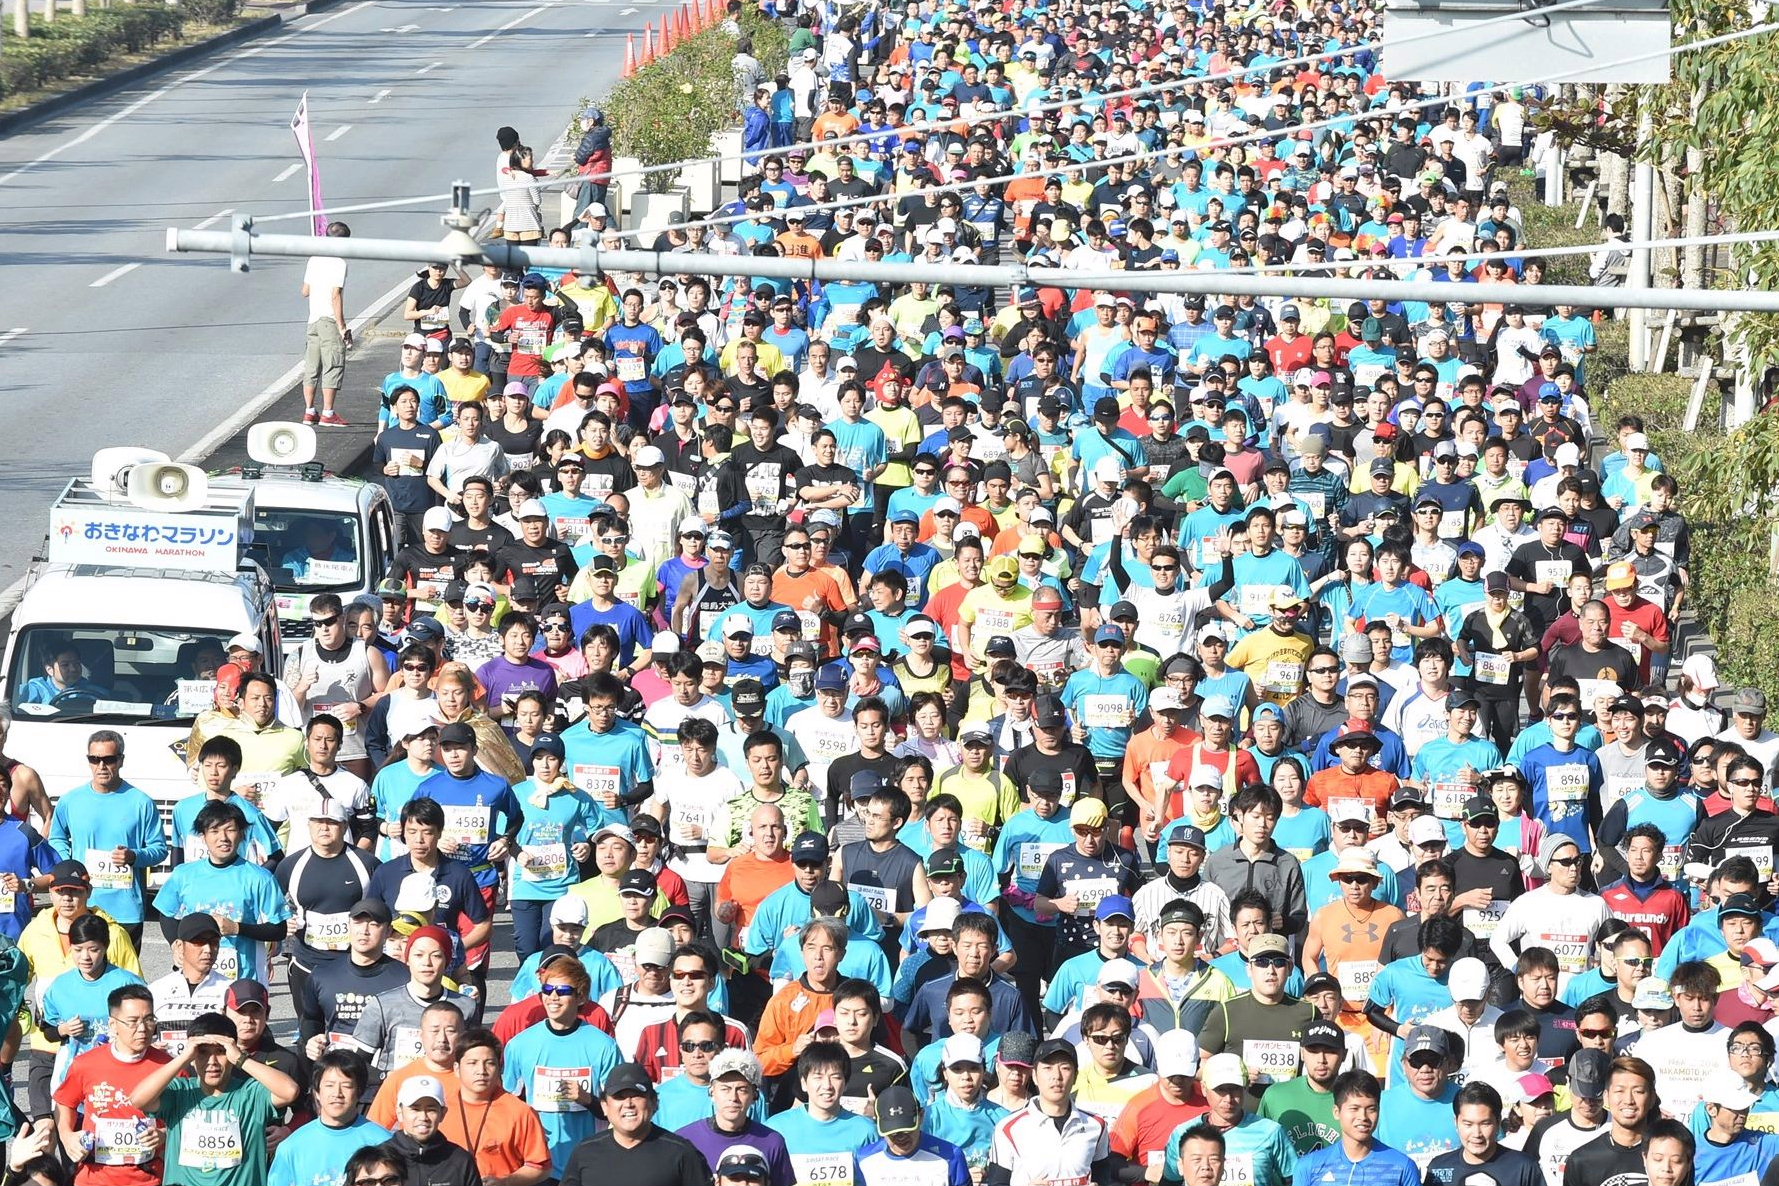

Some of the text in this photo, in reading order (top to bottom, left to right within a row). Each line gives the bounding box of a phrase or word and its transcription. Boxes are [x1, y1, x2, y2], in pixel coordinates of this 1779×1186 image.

[84, 521, 234, 546] おきなわマラソン
[105, 546, 205, 557] OKINAWA MARATHON
[985, 617, 1009, 629] 6388
[1158, 613, 1182, 623] 8762
[1097, 703, 1123, 713] 9098
[819, 738, 847, 752] 9598
[586, 778, 615, 790] 8378
[1560, 774, 1586, 785] 8961
[456, 816, 485, 829] 4583
[530, 853, 565, 867] 12806
[318, 922, 350, 936] 7503
[1554, 944, 1584, 956] 6077
[167, 1002, 218, 1012] TREK
[1261, 1052, 1295, 1066] 9838
[548, 1080, 590, 1093] 120
[198, 1134, 236, 1149] 8856
[809, 1165, 848, 1179] 6578
